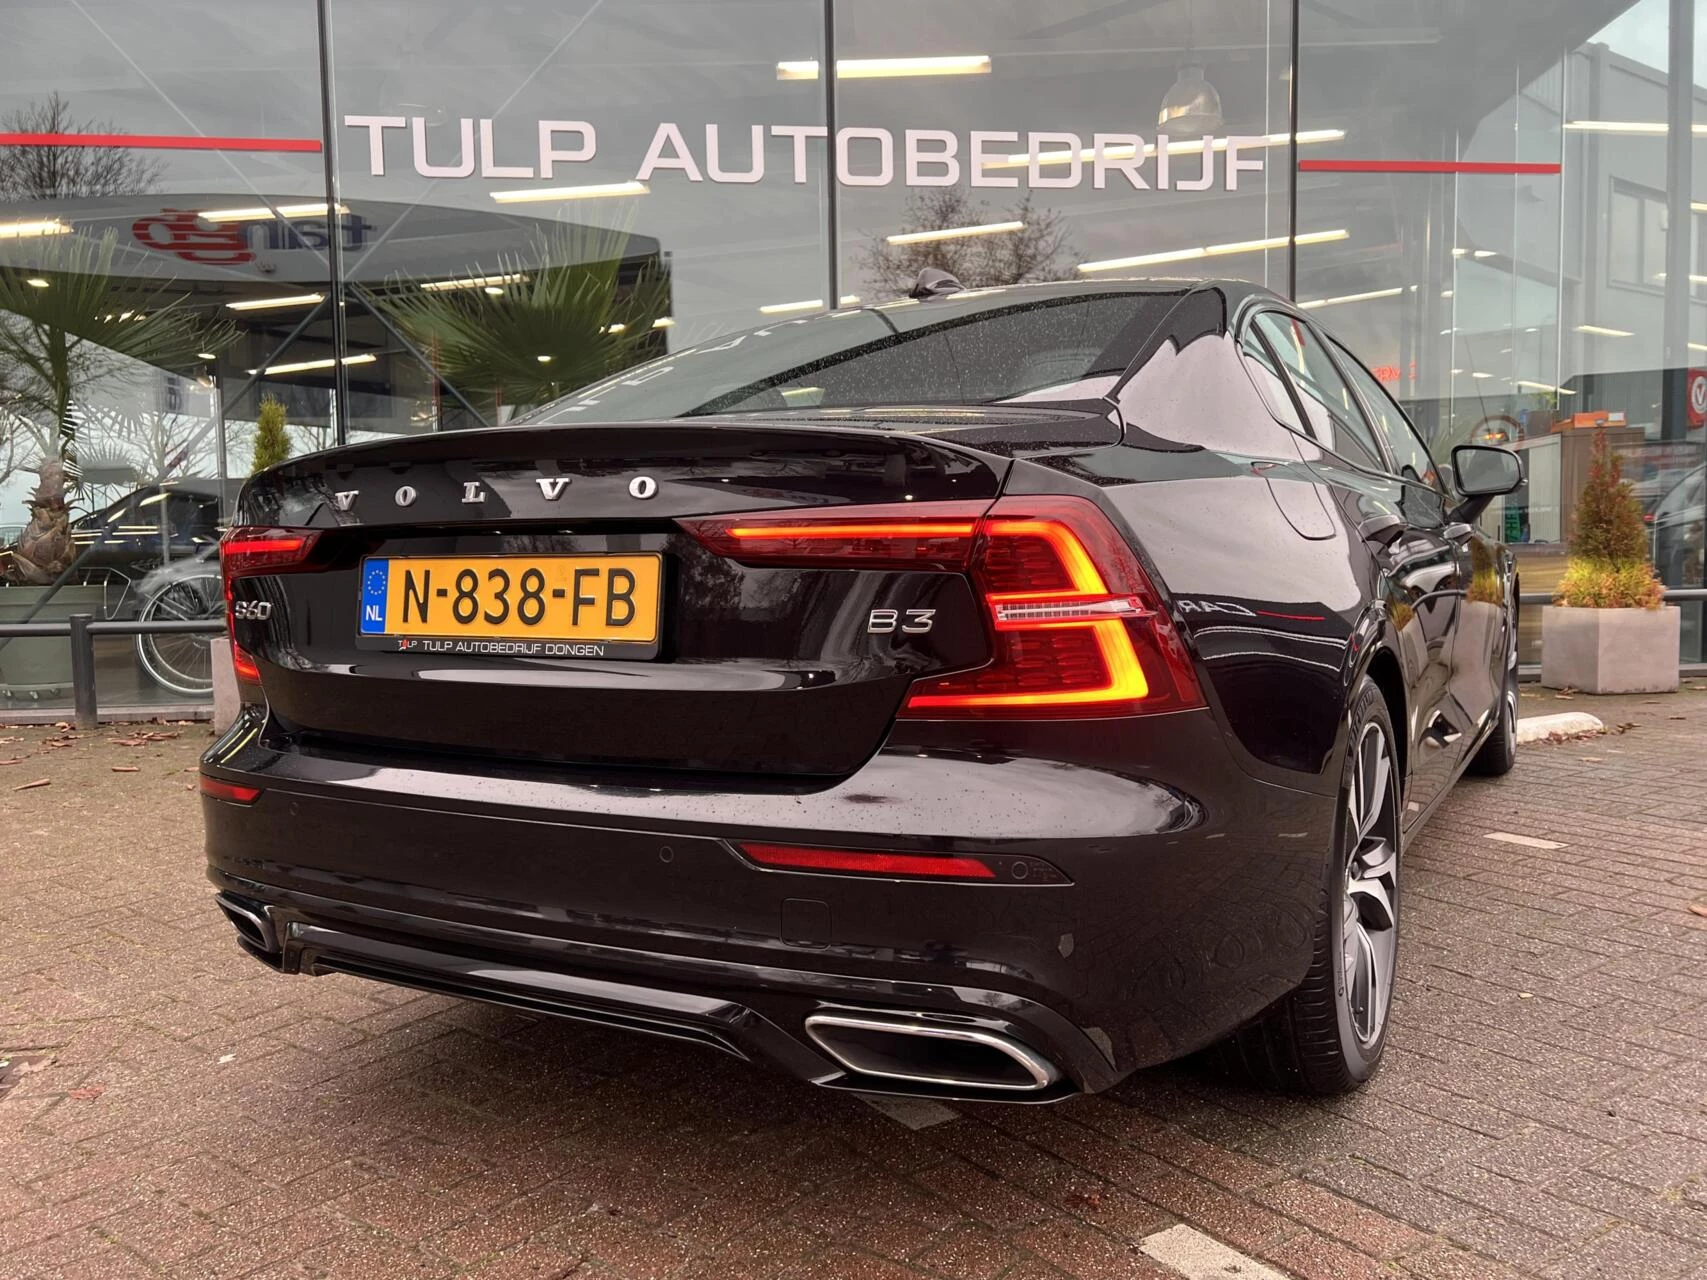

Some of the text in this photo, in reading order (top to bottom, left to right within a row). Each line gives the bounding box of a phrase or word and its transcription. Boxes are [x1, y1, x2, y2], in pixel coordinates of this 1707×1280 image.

[344, 115, 1268, 191] TULP AUTOBEDRIJF
[335, 475, 658, 511] VOLVO
[235, 600, 271, 620] S60
[402, 567, 636, 626] N-838-FB
[365, 605, 383, 621] NL
[422, 640, 604, 656] TULP AUTOBEDRIJF DONGEN
